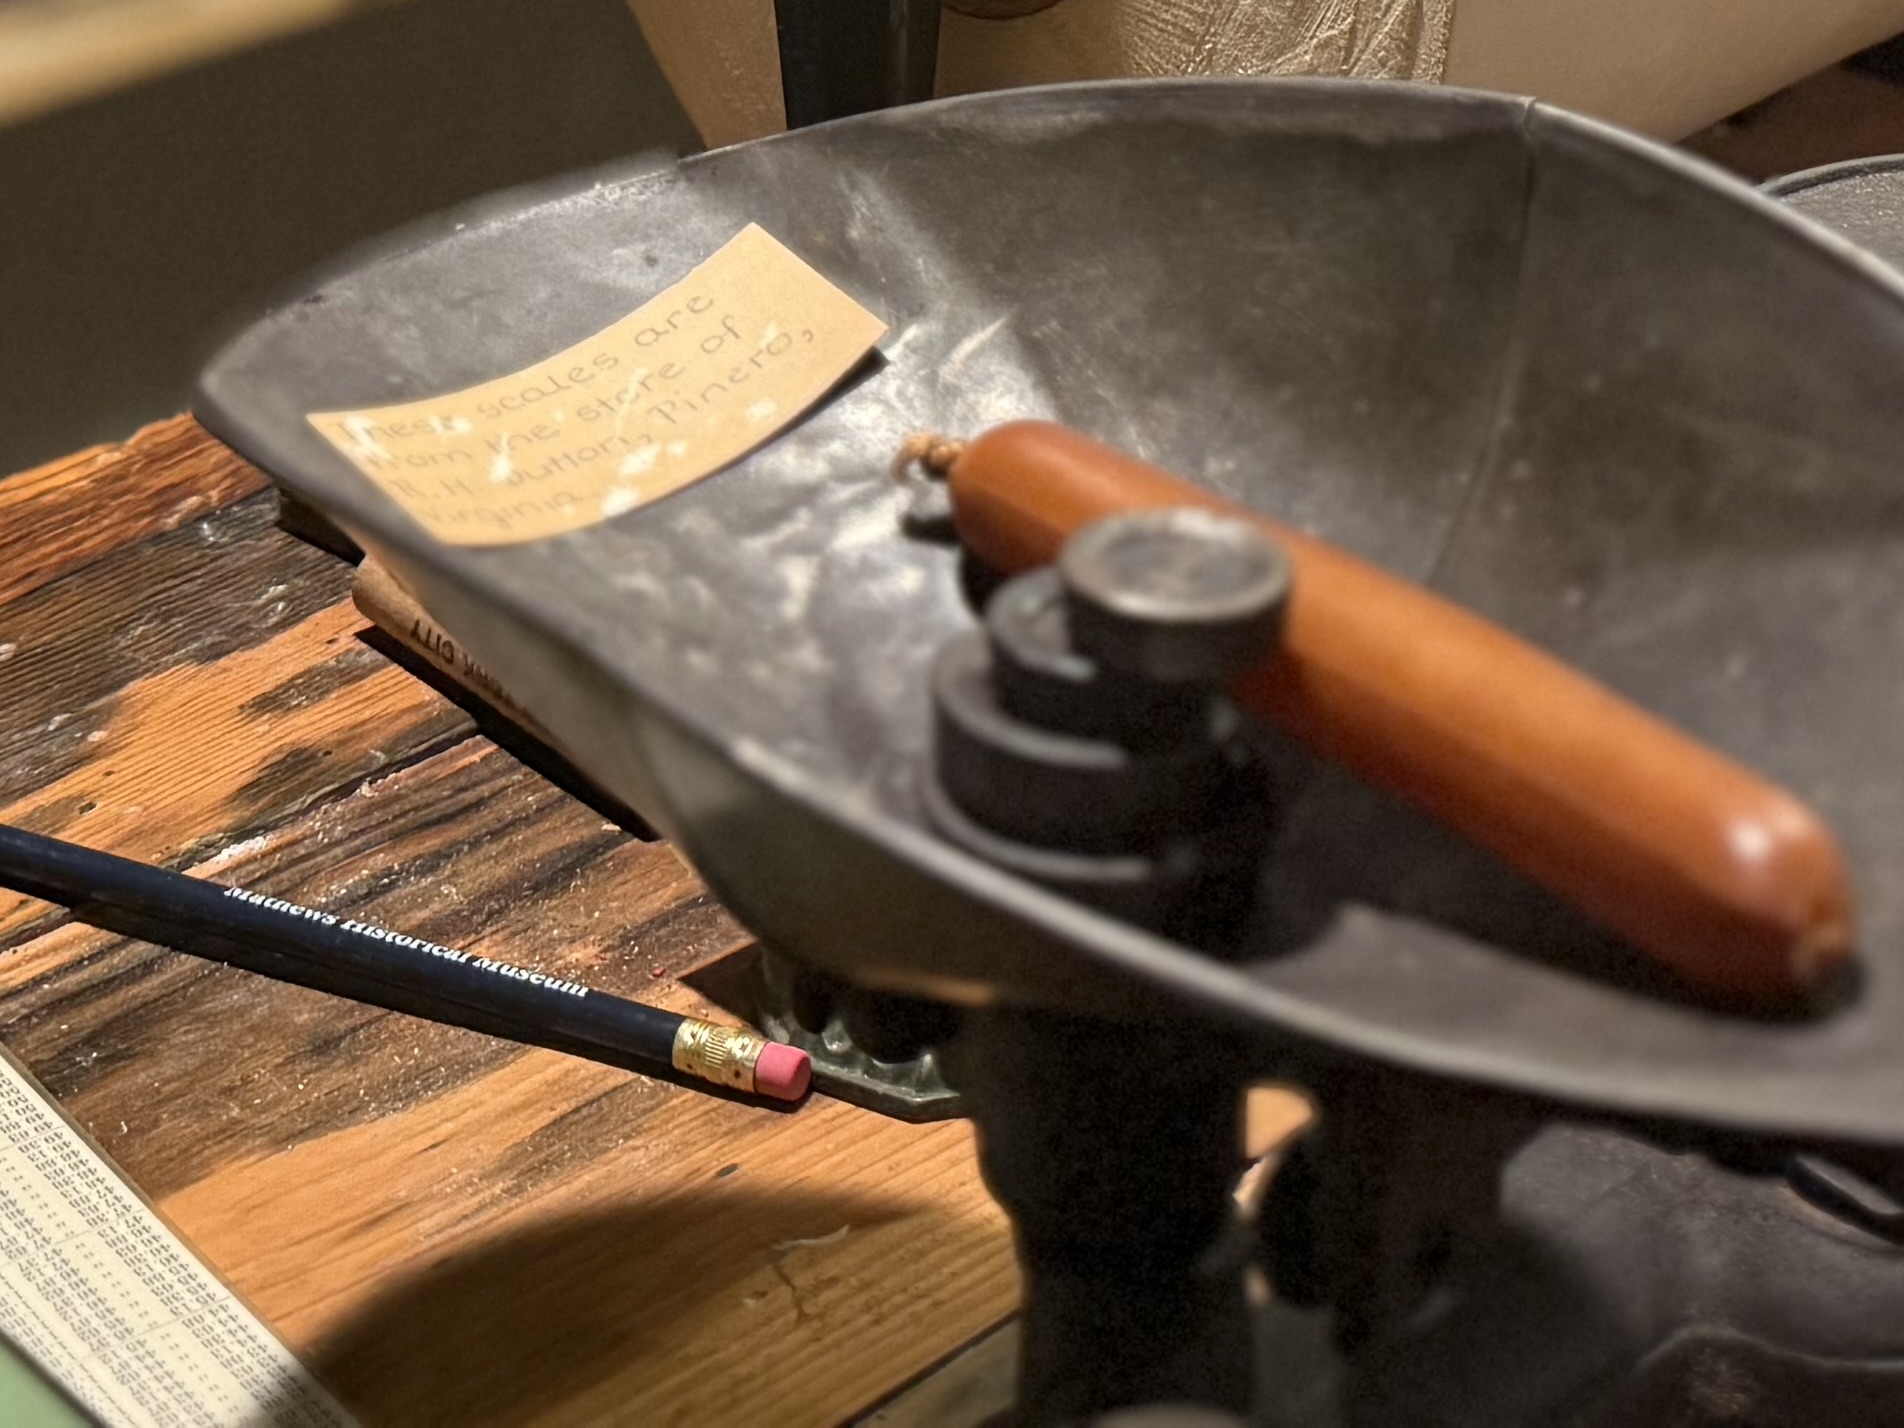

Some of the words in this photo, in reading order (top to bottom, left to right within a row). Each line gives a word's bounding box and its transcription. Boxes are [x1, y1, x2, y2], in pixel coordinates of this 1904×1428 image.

[478, 353, 620, 421] scales
[633, 291, 714, 349] are
[577, 357, 686, 423] store
[700, 312, 750, 357] of
[411, 619, 454, 664] CITY
[223, 886, 341, 926] Mathews
[340, 918, 472, 965] Historical
[472, 955, 589, 998] Museum
